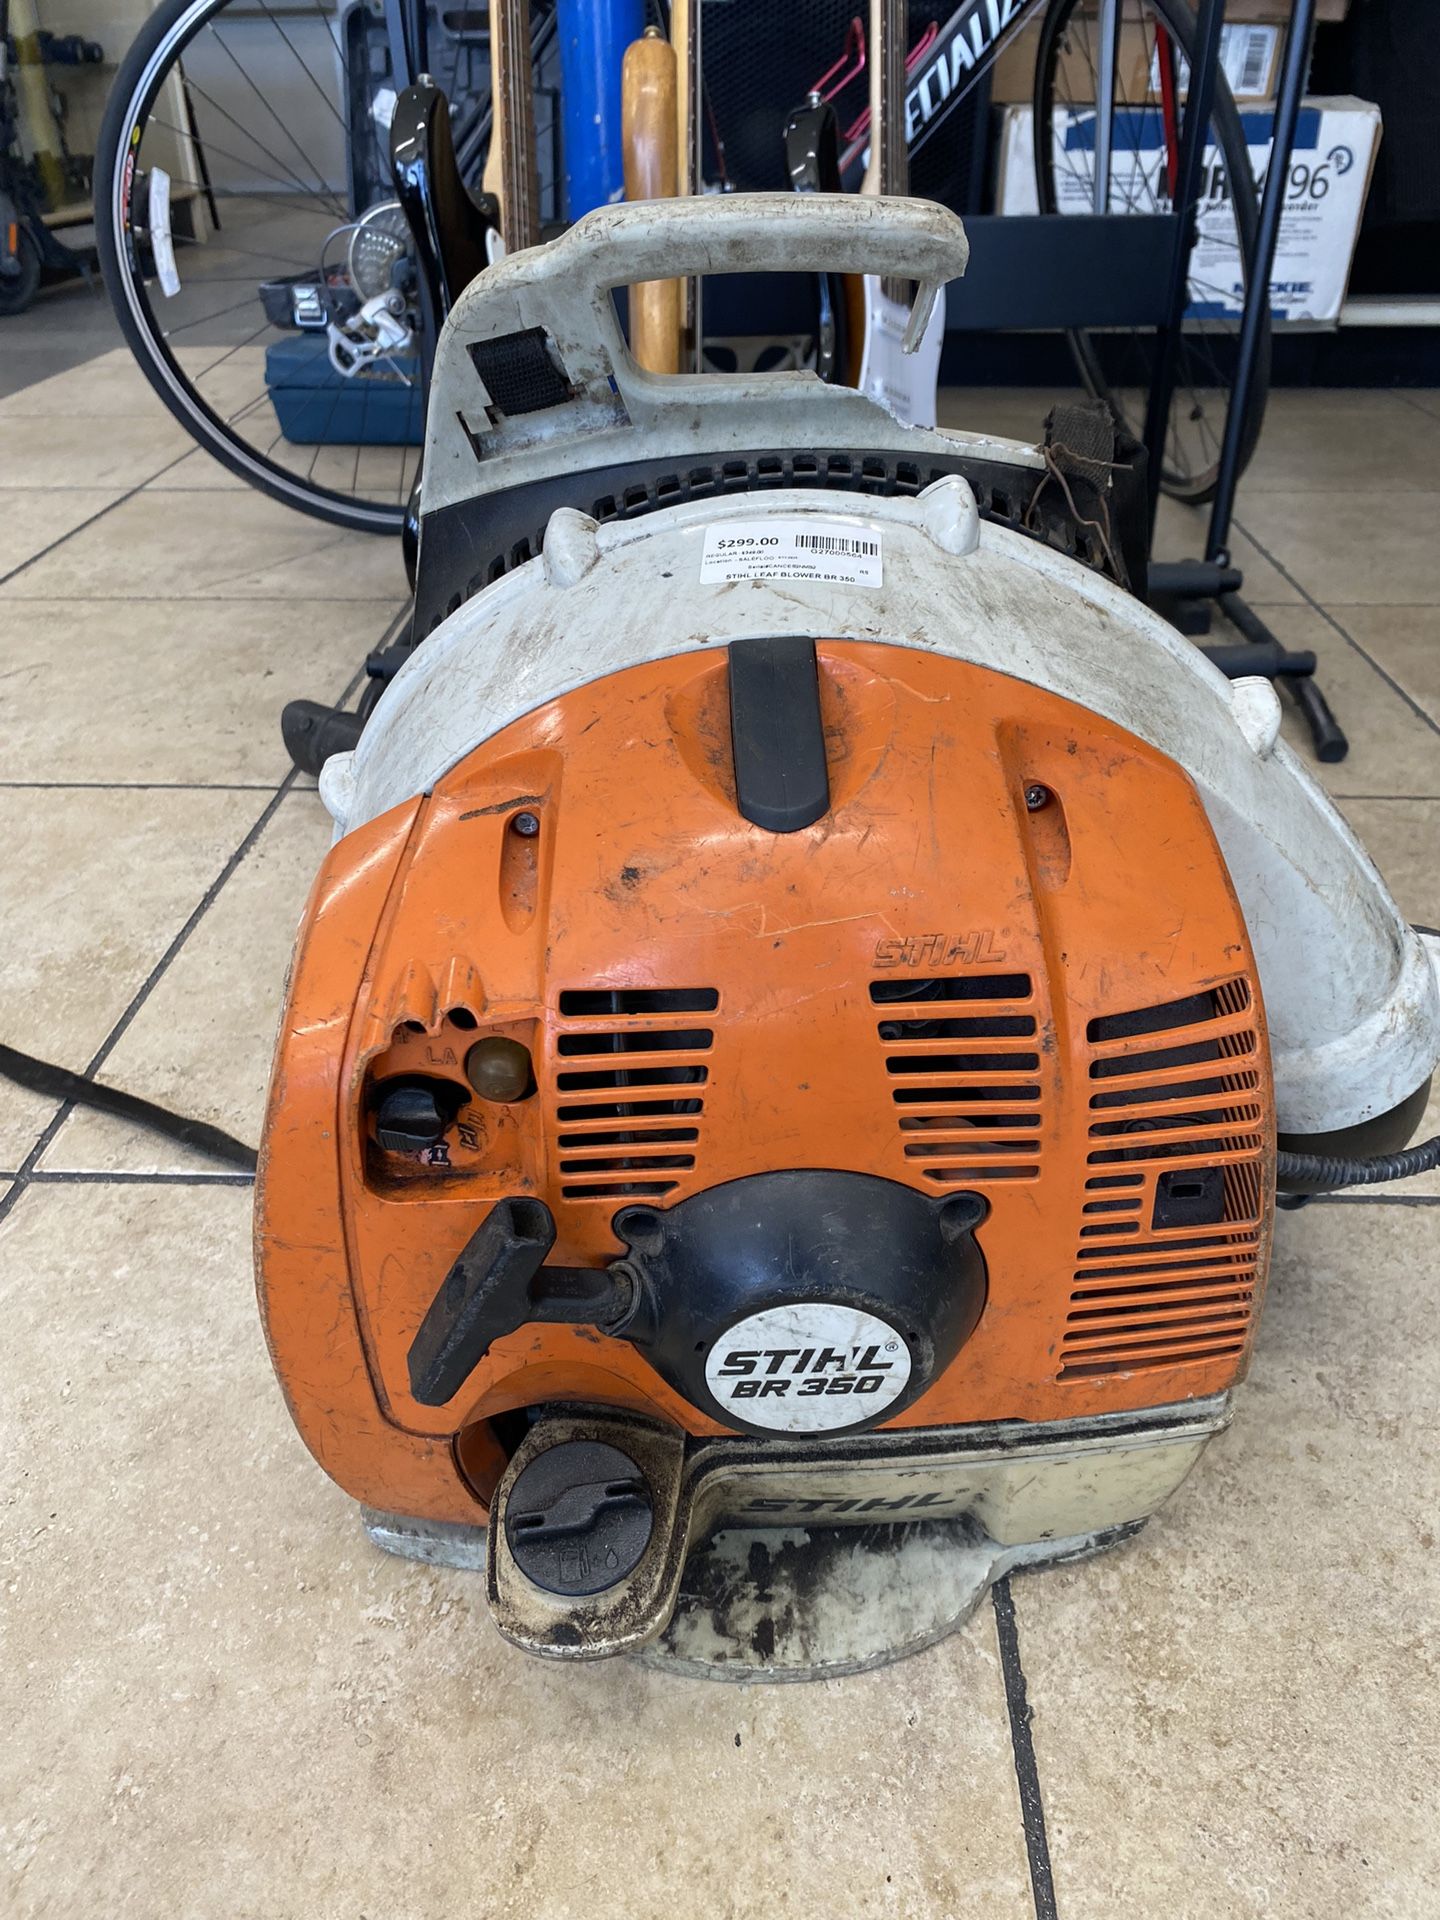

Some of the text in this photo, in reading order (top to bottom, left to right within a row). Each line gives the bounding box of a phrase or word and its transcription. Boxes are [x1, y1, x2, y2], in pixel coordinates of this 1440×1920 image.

[1233, 281, 1312, 293] MCKIE
[717, 537, 779, 550] $299.00
[726, 572, 752, 580] STIHL
[780, 572, 822, 580] BLOWER
[839, 575, 856, 583] 350
[731, 1375, 886, 1399] BR 350
[742, 1491, 956, 1513] STIHL
